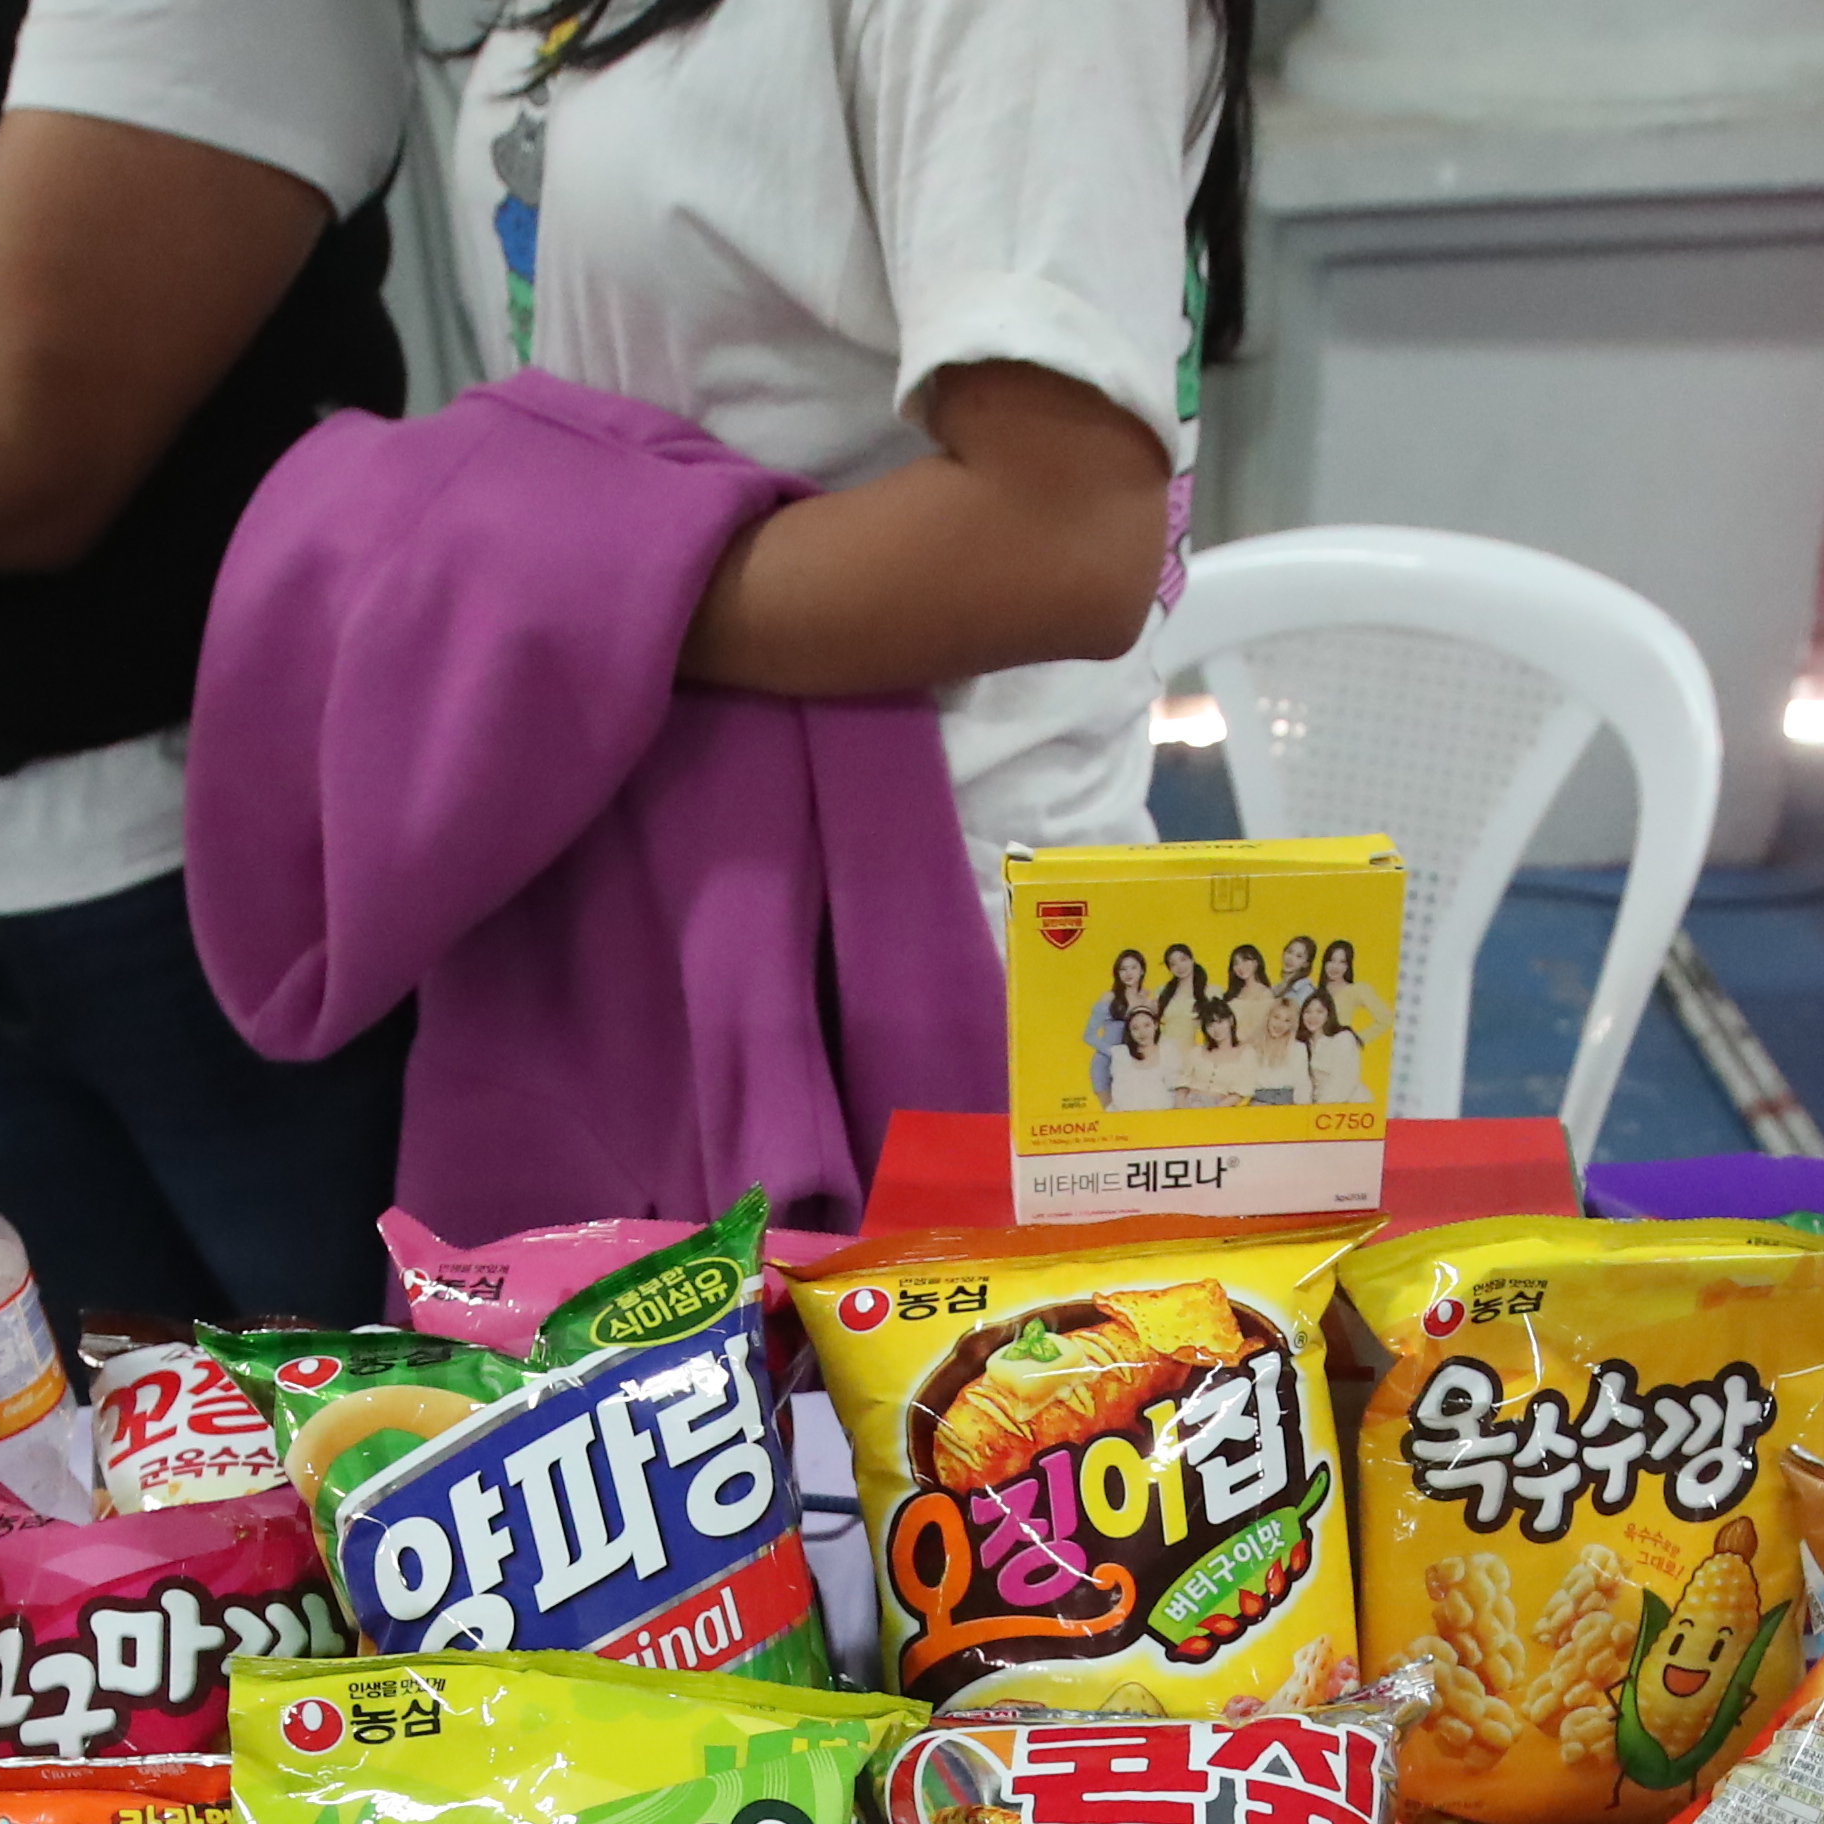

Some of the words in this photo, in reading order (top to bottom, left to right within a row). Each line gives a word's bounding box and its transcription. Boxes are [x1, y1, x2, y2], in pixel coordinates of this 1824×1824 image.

[1030, 1121, 1099, 1138] LEMONA
[1314, 1112, 1376, 1132] C750
[1032, 1171, 1123, 1198] 비타메드
[607, 1269, 732, 1342] 식이섬유
[615, 1264, 686, 1312] 풍부한
[897, 1283, 989, 1322] 농심
[1470, 1290, 1544, 1325] 농심
[138, 1447, 286, 1490] 군옥수수
[1404, 1360, 1766, 1538] 옥수수깡
[373, 1332, 776, 1656] 양파링
[891, 1350, 1289, 1688] 오징어집
[1161, 1517, 1286, 1624] 버터구이맛
[348, 1678, 398, 1700] 인생을
[349, 1699, 443, 1746] 농심
